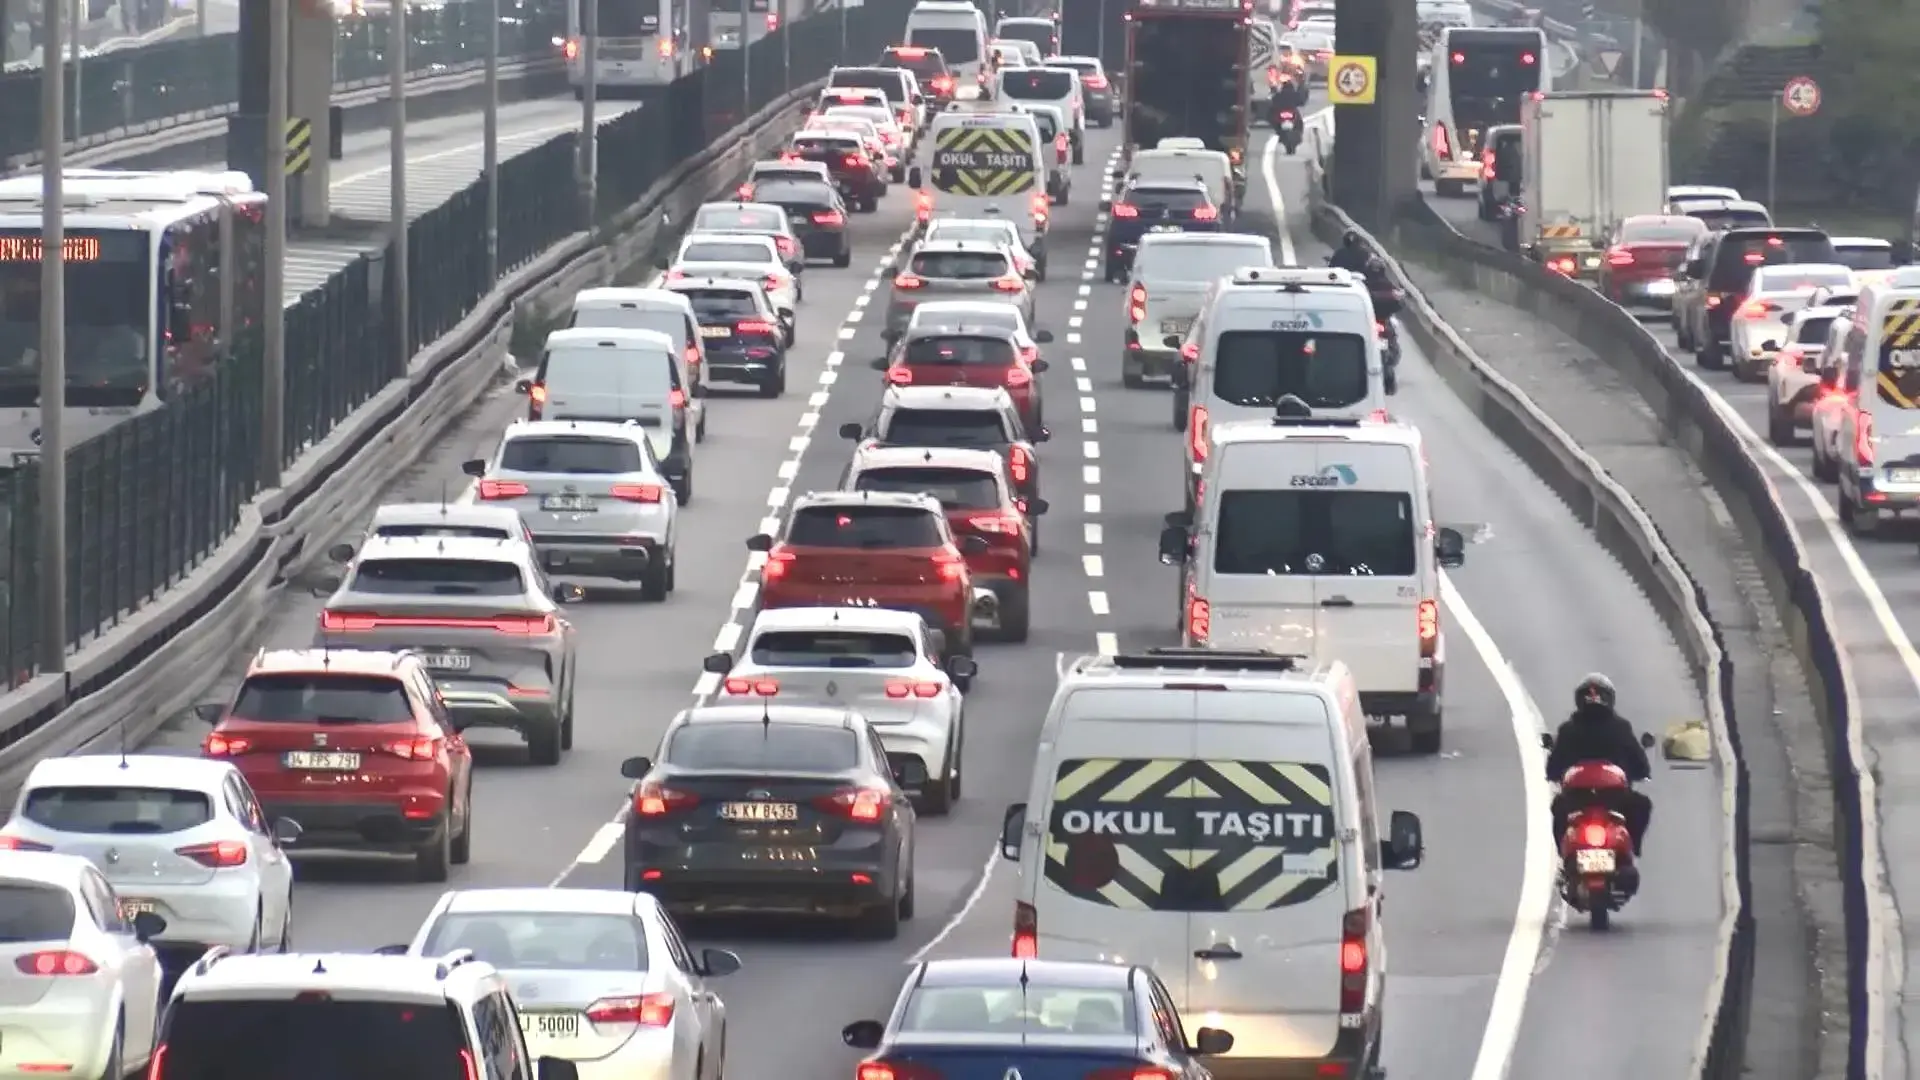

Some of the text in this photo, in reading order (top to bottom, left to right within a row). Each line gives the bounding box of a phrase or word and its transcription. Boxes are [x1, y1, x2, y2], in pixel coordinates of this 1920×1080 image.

[941, 153, 1027, 168] OKUL TAŞITI
[723, 803, 737, 817] 34
[1061, 810, 1323, 842] OKUL TAŞITI
[538, 1016, 574, 1032] 5000
